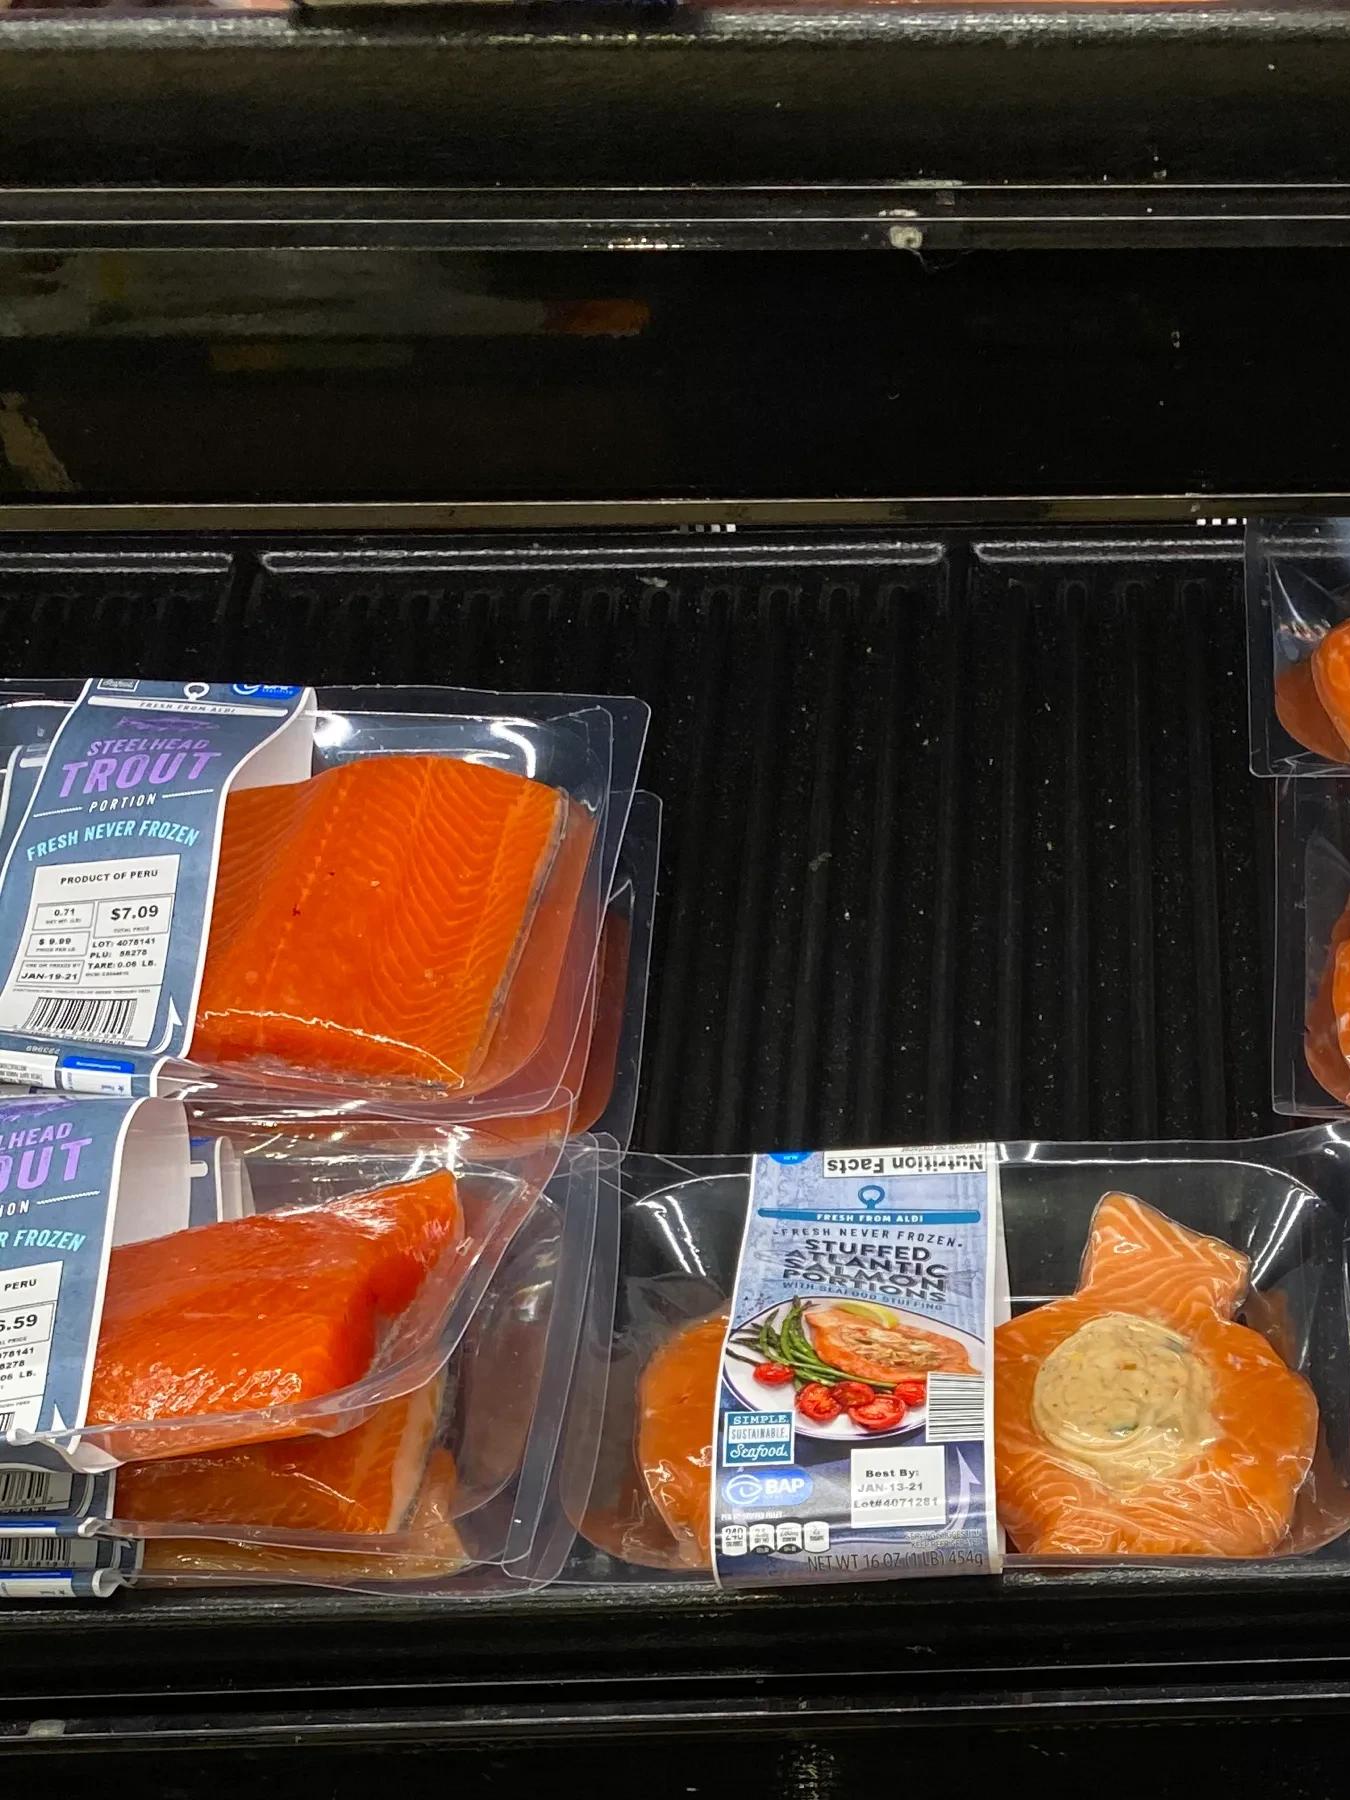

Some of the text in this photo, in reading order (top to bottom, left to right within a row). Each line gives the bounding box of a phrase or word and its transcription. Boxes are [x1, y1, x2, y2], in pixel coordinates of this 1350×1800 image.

[87, 739, 211, 755] STEELHEAD
[59, 752, 222, 798] TROUT
[89, 793, 157, 813] PORTION
[26, 819, 200, 861] FRESH NEVER FROZEN
[60, 869, 158, 885] PRODUCT OF PERU
[111, 905, 159, 921] $7.09
[828, 1157, 982, 1174] Nutrition Facts
[14, 1229, 86, 1252] FROZEN
[805, 1239, 931, 1262] STUFFED
[5, 1280, 37, 1291] PERU
[765, 1477, 805, 1495] BAP
[858, 1482, 923, 1492] JAN-13-21
